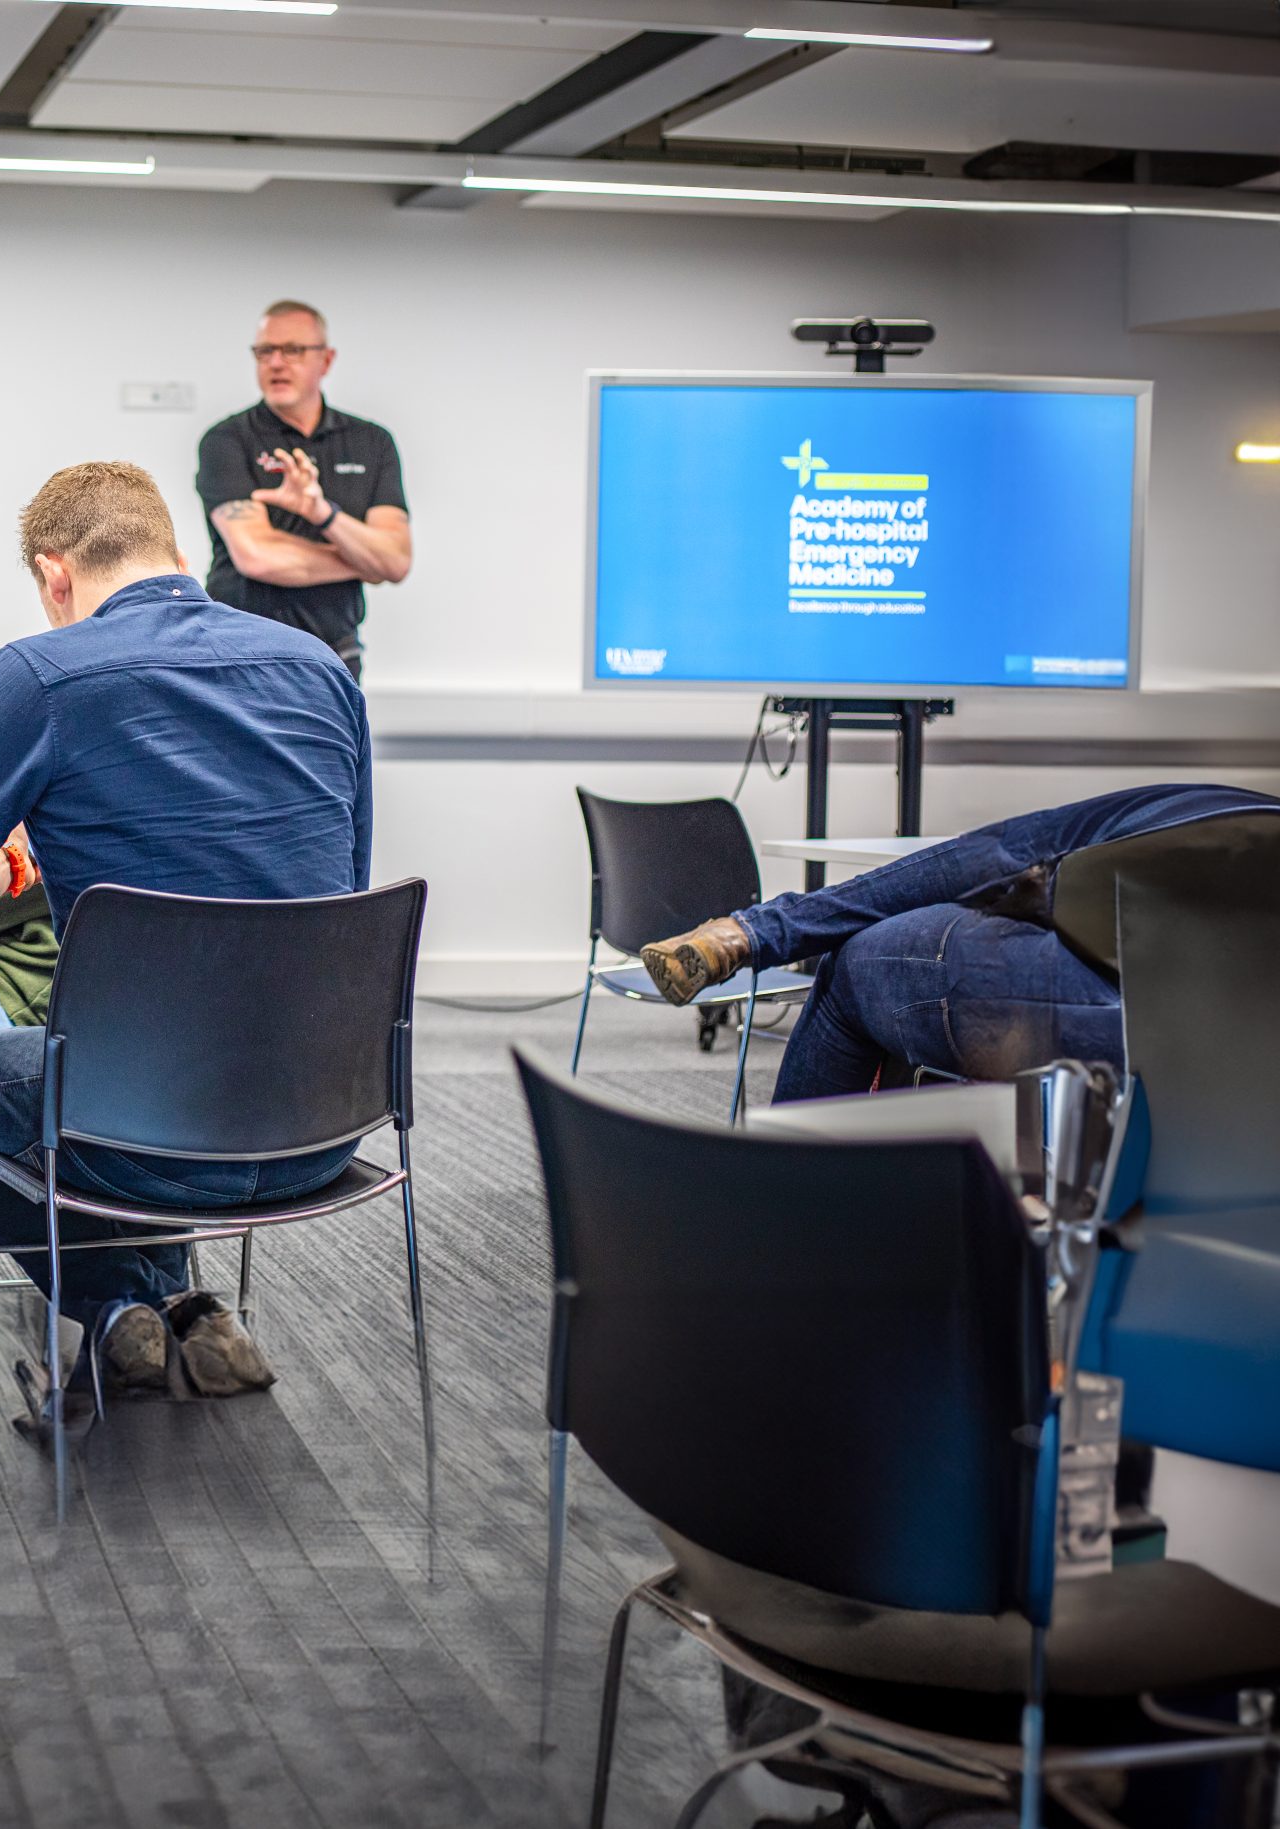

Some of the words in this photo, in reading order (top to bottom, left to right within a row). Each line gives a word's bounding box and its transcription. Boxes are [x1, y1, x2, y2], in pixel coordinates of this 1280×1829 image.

[790, 495, 899, 521] Academy
[901, 497, 927, 519] of
[789, 517, 928, 544] Pre-hospital
[789, 539, 920, 568] Emergency
[789, 562, 894, 586] Medicine
